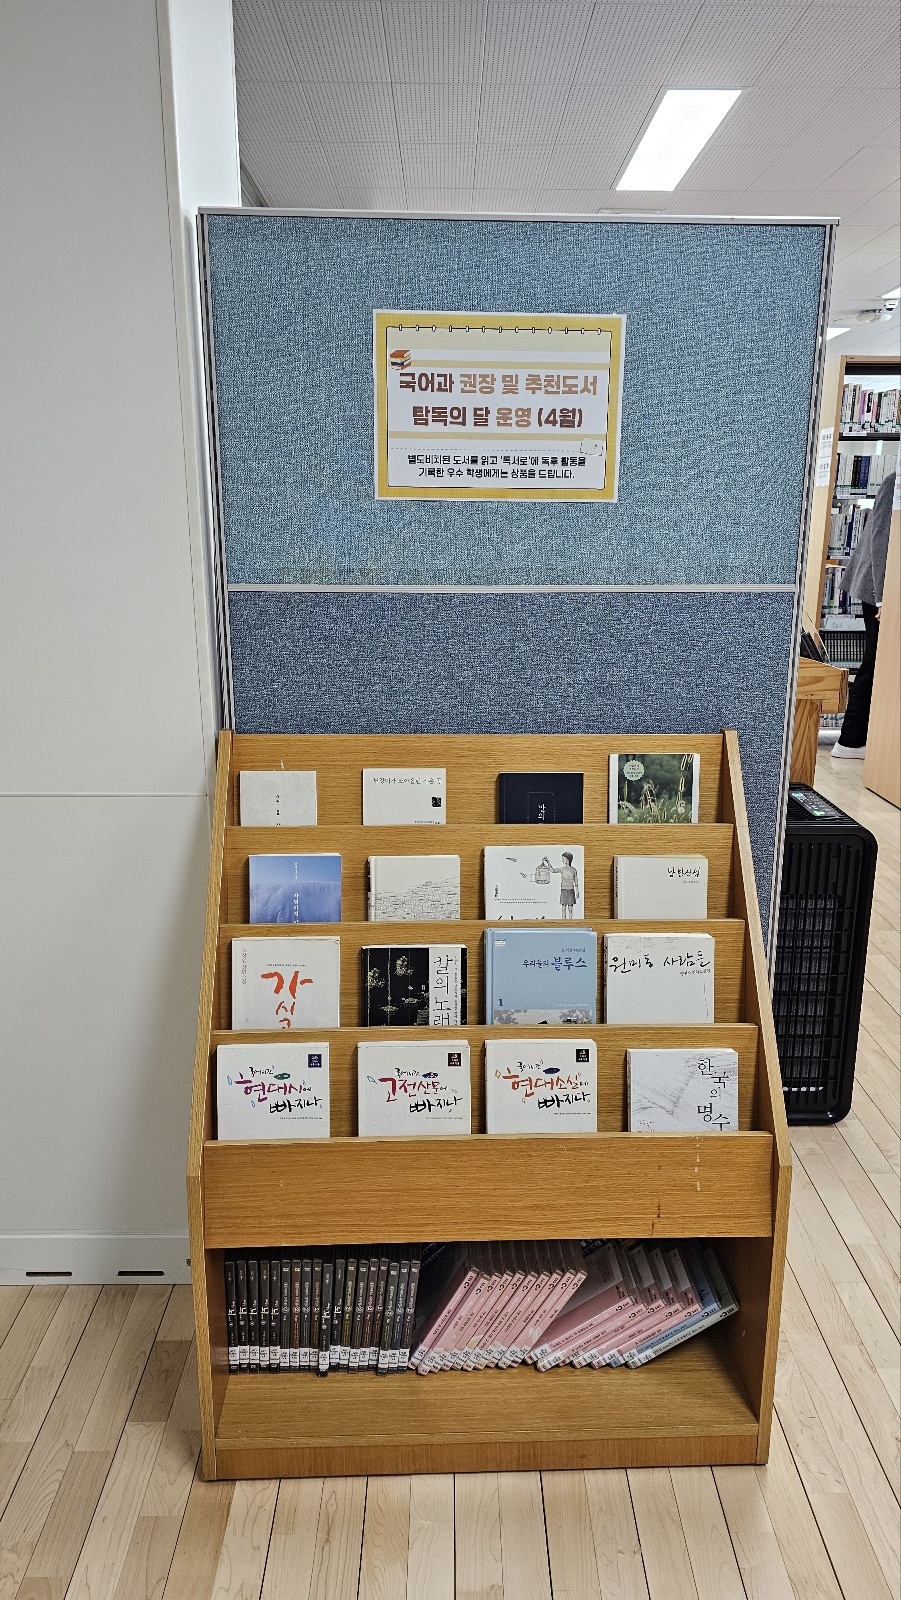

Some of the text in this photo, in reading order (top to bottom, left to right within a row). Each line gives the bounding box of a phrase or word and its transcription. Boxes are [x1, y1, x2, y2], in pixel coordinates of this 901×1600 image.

[399, 373, 598, 396] 국어과 권장 및 추천도서
[412, 405, 583, 428] 탐독의 달 운영 (4월)
[407, 454, 451, 465] 별도비치된
[452, 455, 478, 465] 도서를
[480, 455, 498, 466] 읽고
[541, 456, 559, 466] 독후
[560, 456, 587, 467] 활동을
[418, 468, 575, 479] 기록한 우수 학생에게는 상품을 드립니다.
[551, 956, 588, 971] 블루스
[663, 951, 711, 968] 사람들
[433, 954, 453, 995] 칼의
[498, 999, 504, 1007] 1
[697, 1058, 729, 1101] 한국의
[269, 1096, 323, 1114] 빠지다
[409, 1096, 464, 1113] 빠지다
[537, 1091, 591, 1109] 빠지다
